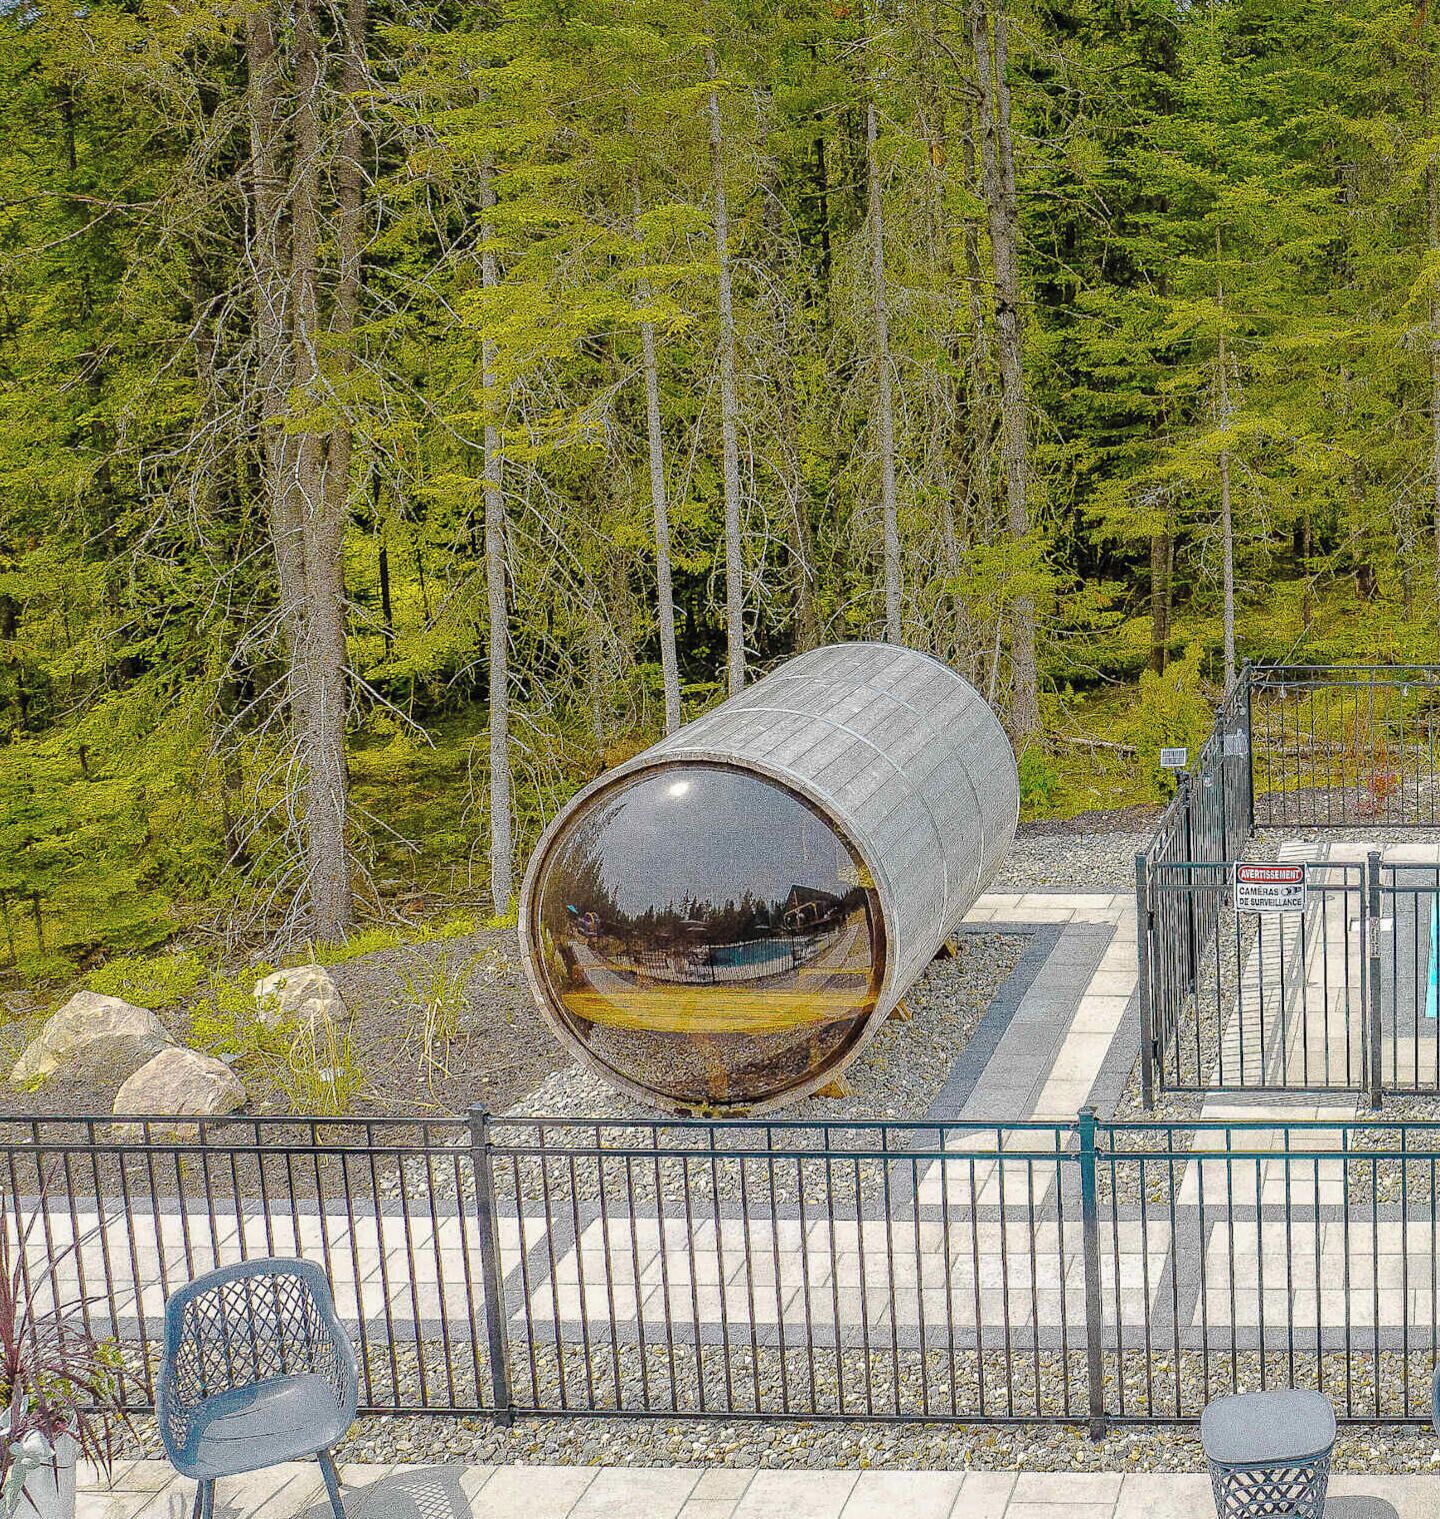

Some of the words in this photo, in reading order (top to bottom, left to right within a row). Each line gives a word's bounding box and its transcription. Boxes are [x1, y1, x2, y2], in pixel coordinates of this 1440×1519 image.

[1241, 869, 1299, 880] AVERTISSEMENT
[1239, 898, 1249, 906] DE
[1250, 898, 1302, 906] SURVEILLANCE
